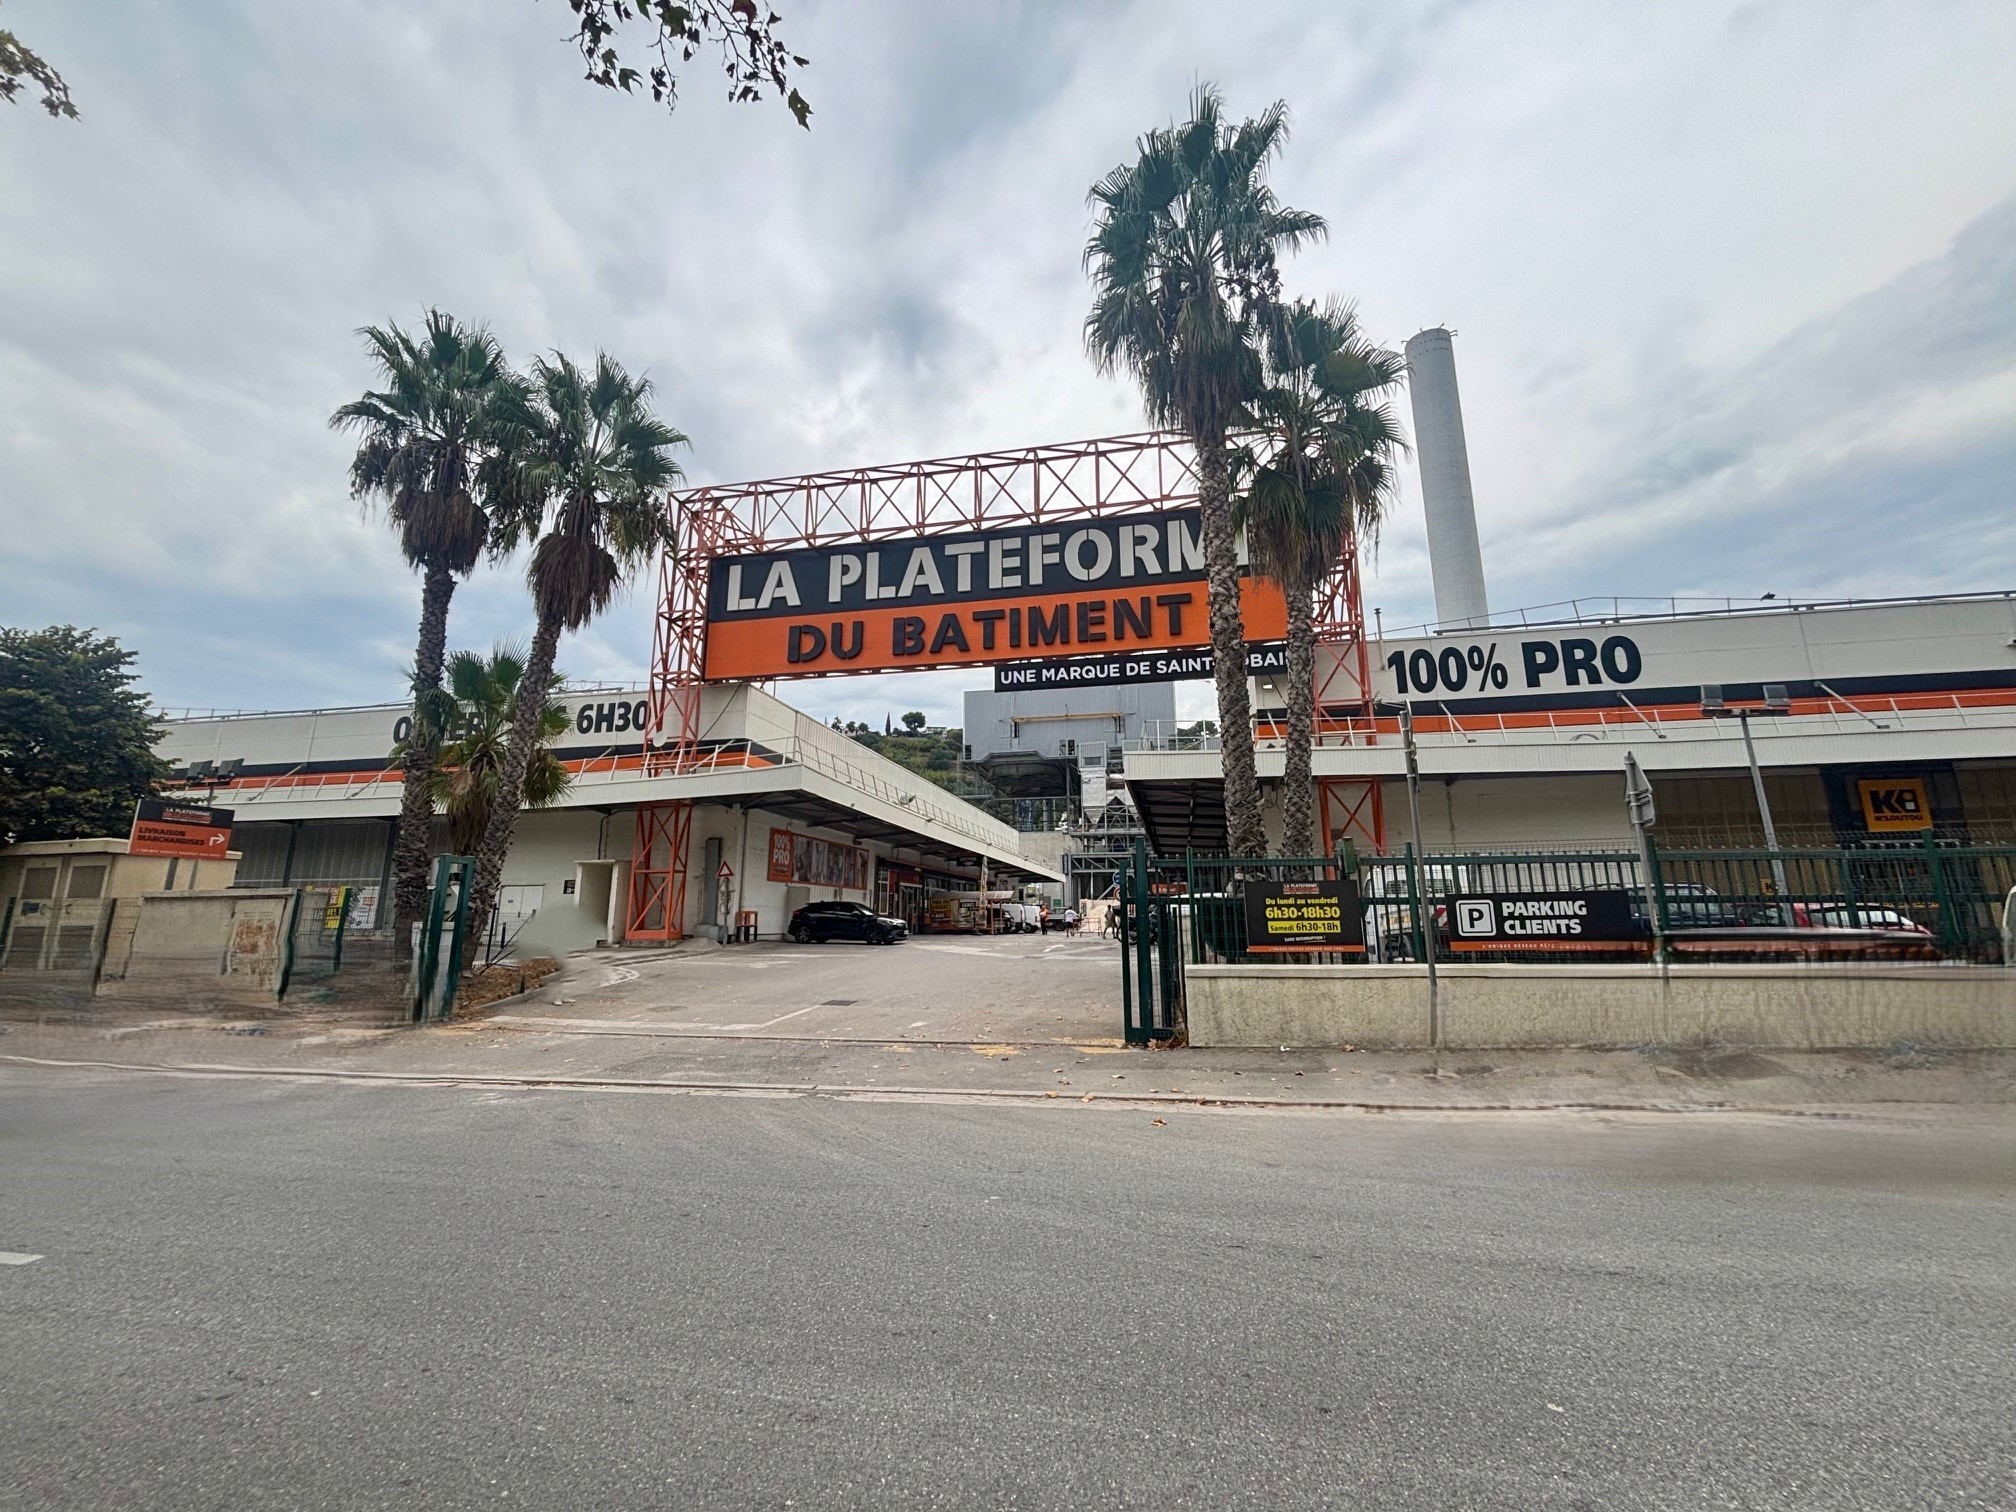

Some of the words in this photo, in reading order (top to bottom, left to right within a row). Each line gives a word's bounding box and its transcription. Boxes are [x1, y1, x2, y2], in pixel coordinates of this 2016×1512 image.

[726, 560, 801, 612] LA
[828, 518, 1249, 603] PLATEFORM
[787, 620, 864, 664] DU
[892, 592, 1193, 656] BATIMENT
[1000, 669, 1036, 685] UNE
[1041, 663, 1120, 682] MARQUE
[1126, 661, 1150, 676] DE
[1156, 651, 1286, 674] SAINT-BAI
[1387, 642, 1509, 695] 100%
[1521, 635, 1643, 688] PRO
[576, 700, 649, 735] 6H30
[136, 834, 206, 846] MARCHANDISES
[138, 826, 187, 837] LIVRAISON
[773, 848, 790, 865] PRO
[1277, 897, 1295, 905] lundi
[1502, 900, 1587, 917] PARKING
[1265, 906, 1341, 919] 6h30-18h30
[1469, 908, 1484, 929] P
[1270, 924, 1295, 932] Samedi
[1296, 922, 1339, 931] 6h30-18h
[1503, 918, 1582, 935] CLIENTS
